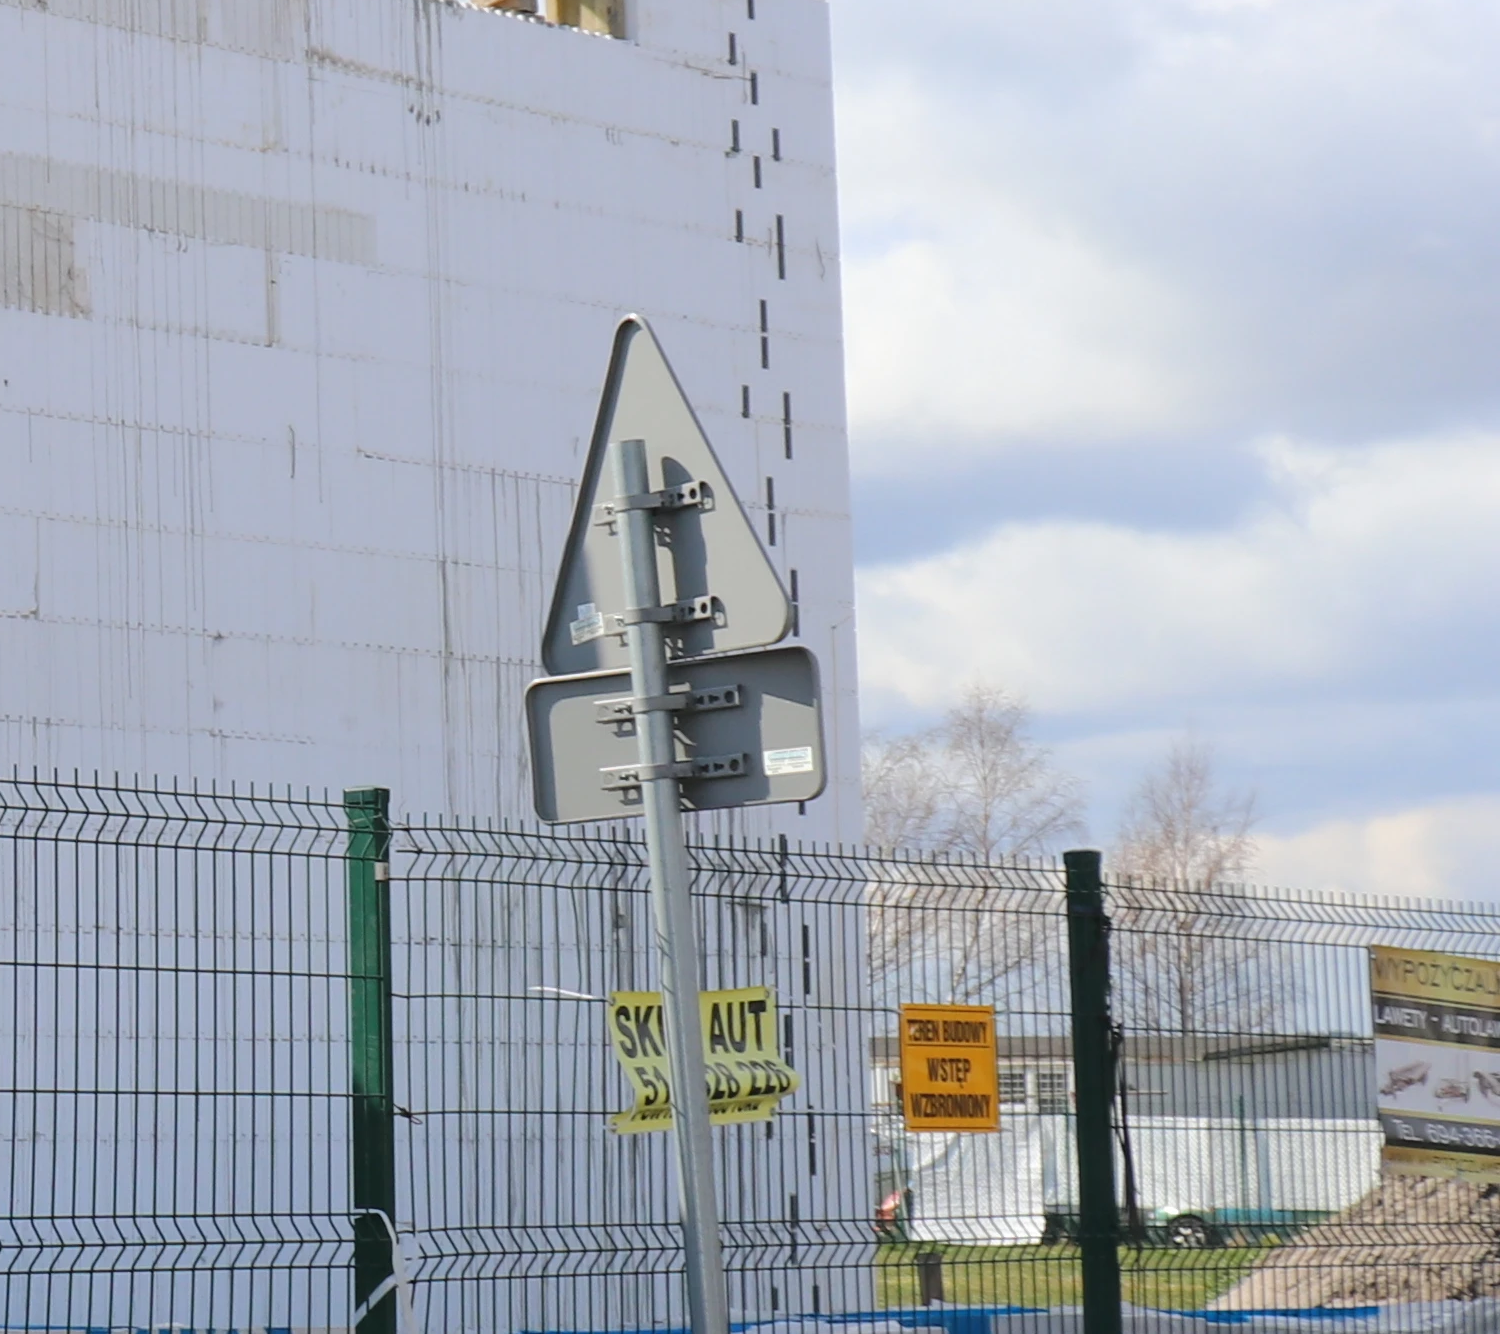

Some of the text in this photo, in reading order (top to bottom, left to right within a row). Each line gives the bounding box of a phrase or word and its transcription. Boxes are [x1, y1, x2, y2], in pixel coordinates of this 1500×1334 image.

[1374, 957, 1500, 996] WYPOŻYCZAL
[615, 1000, 767, 1059] SK AUT
[942, 1020, 988, 1043] BUDOWY
[926, 1057, 972, 1089] WSTĘP
[909, 1092, 992, 1119] WZBRONIONY
